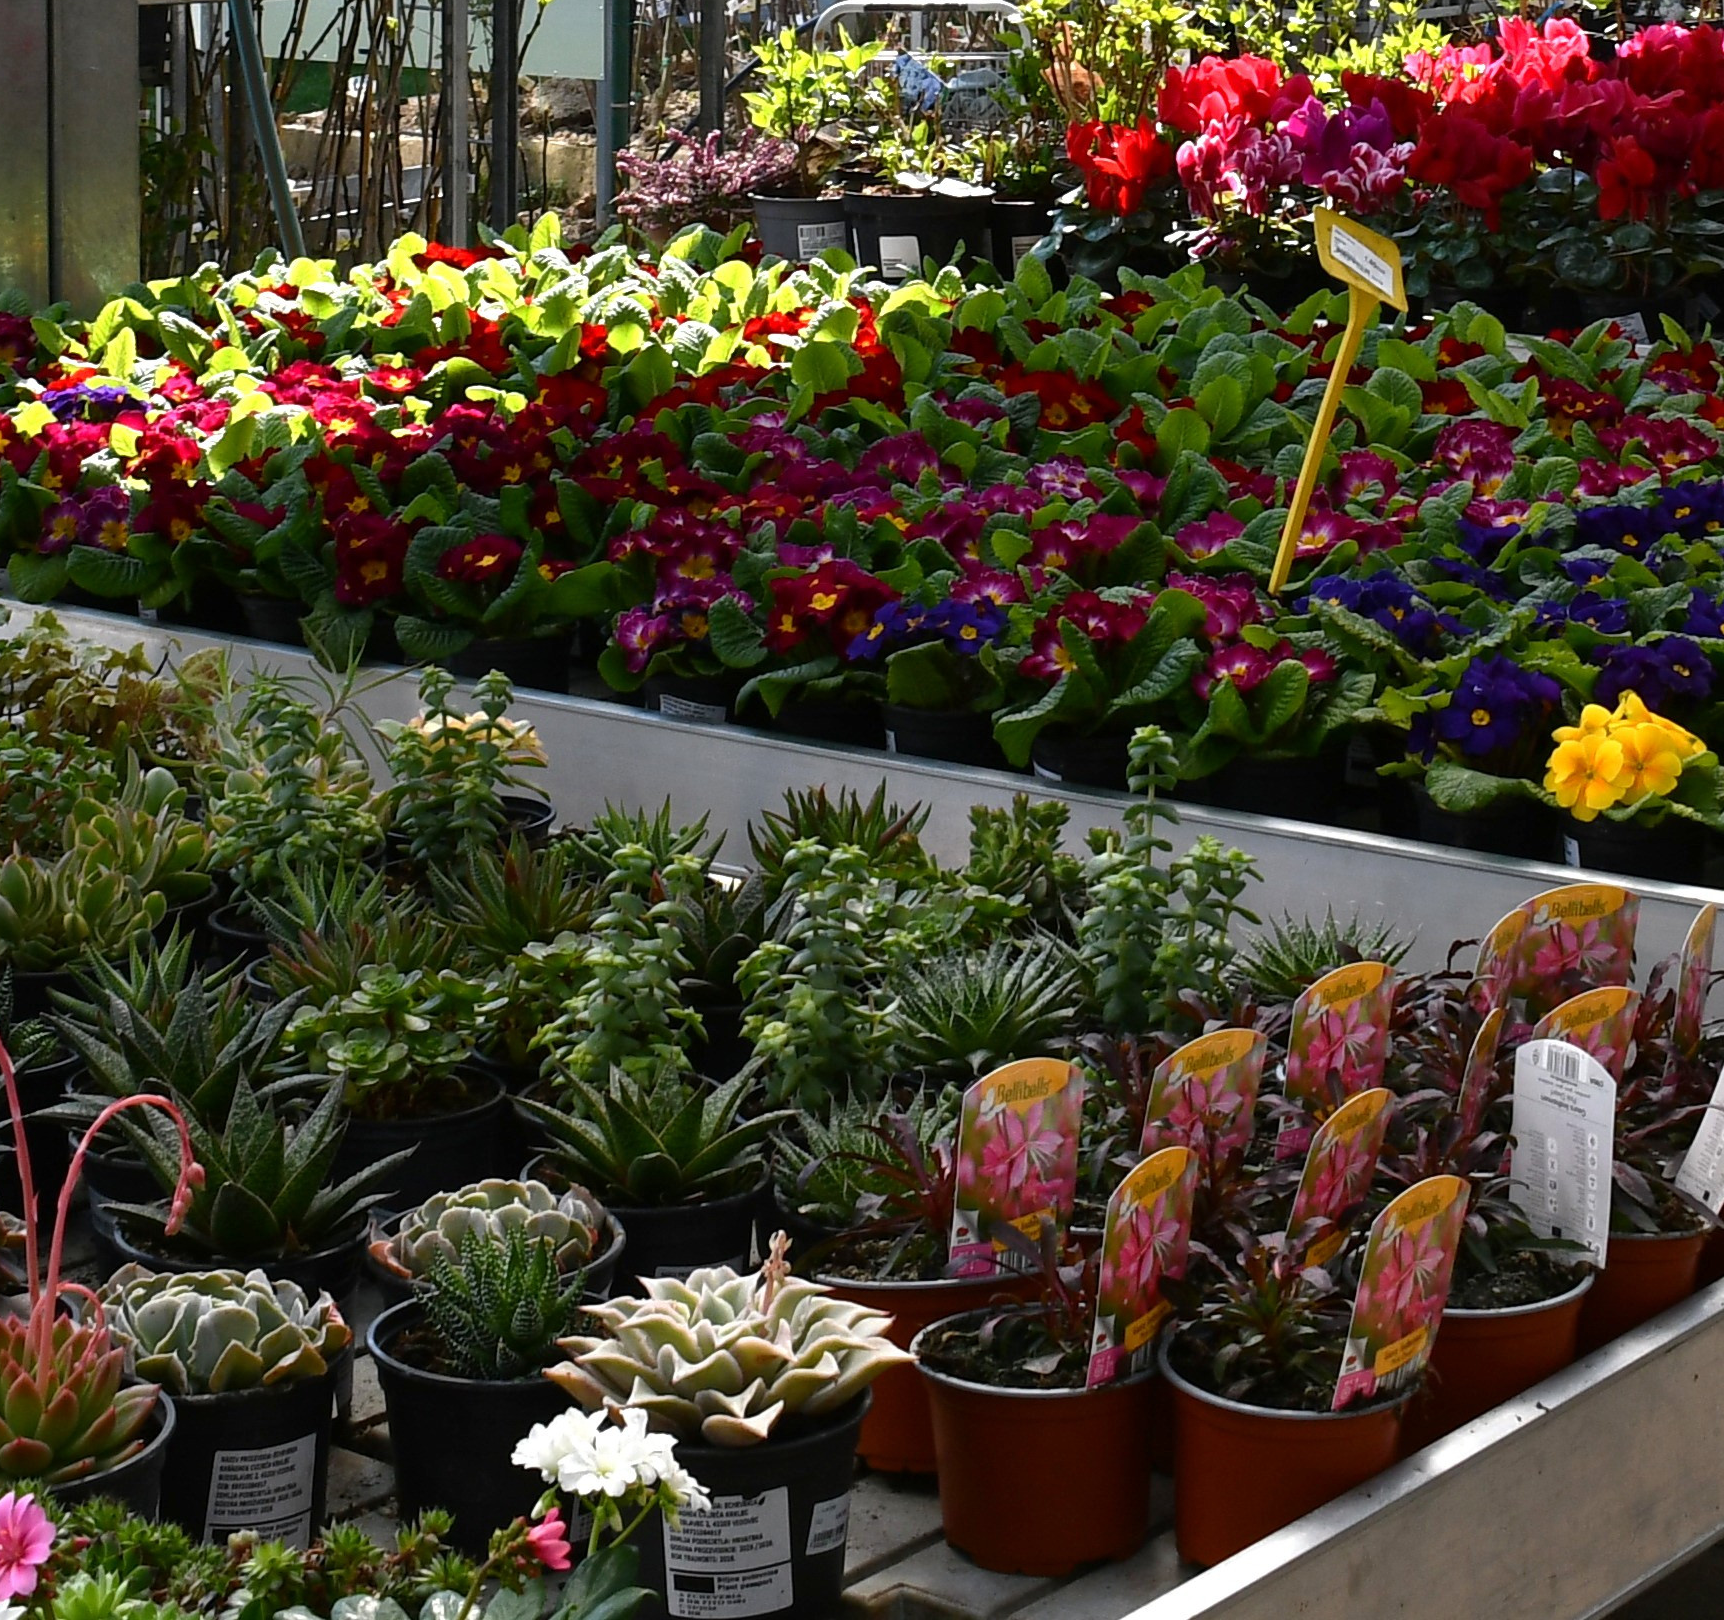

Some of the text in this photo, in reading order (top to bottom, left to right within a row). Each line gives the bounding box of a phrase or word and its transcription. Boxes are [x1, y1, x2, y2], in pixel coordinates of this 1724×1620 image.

[1552, 900, 1606, 919] Bellibells
[1322, 980, 1367, 1004] Bellibells
[1562, 1004, 1611, 1027] Bellibells
[1185, 1046, 1235, 1072] Bellibells
[997, 1076, 1051, 1103] Bellibells
[1132, 1166, 1172, 1201] Bellibells
[1396, 1195, 1442, 1226] Bellibells
